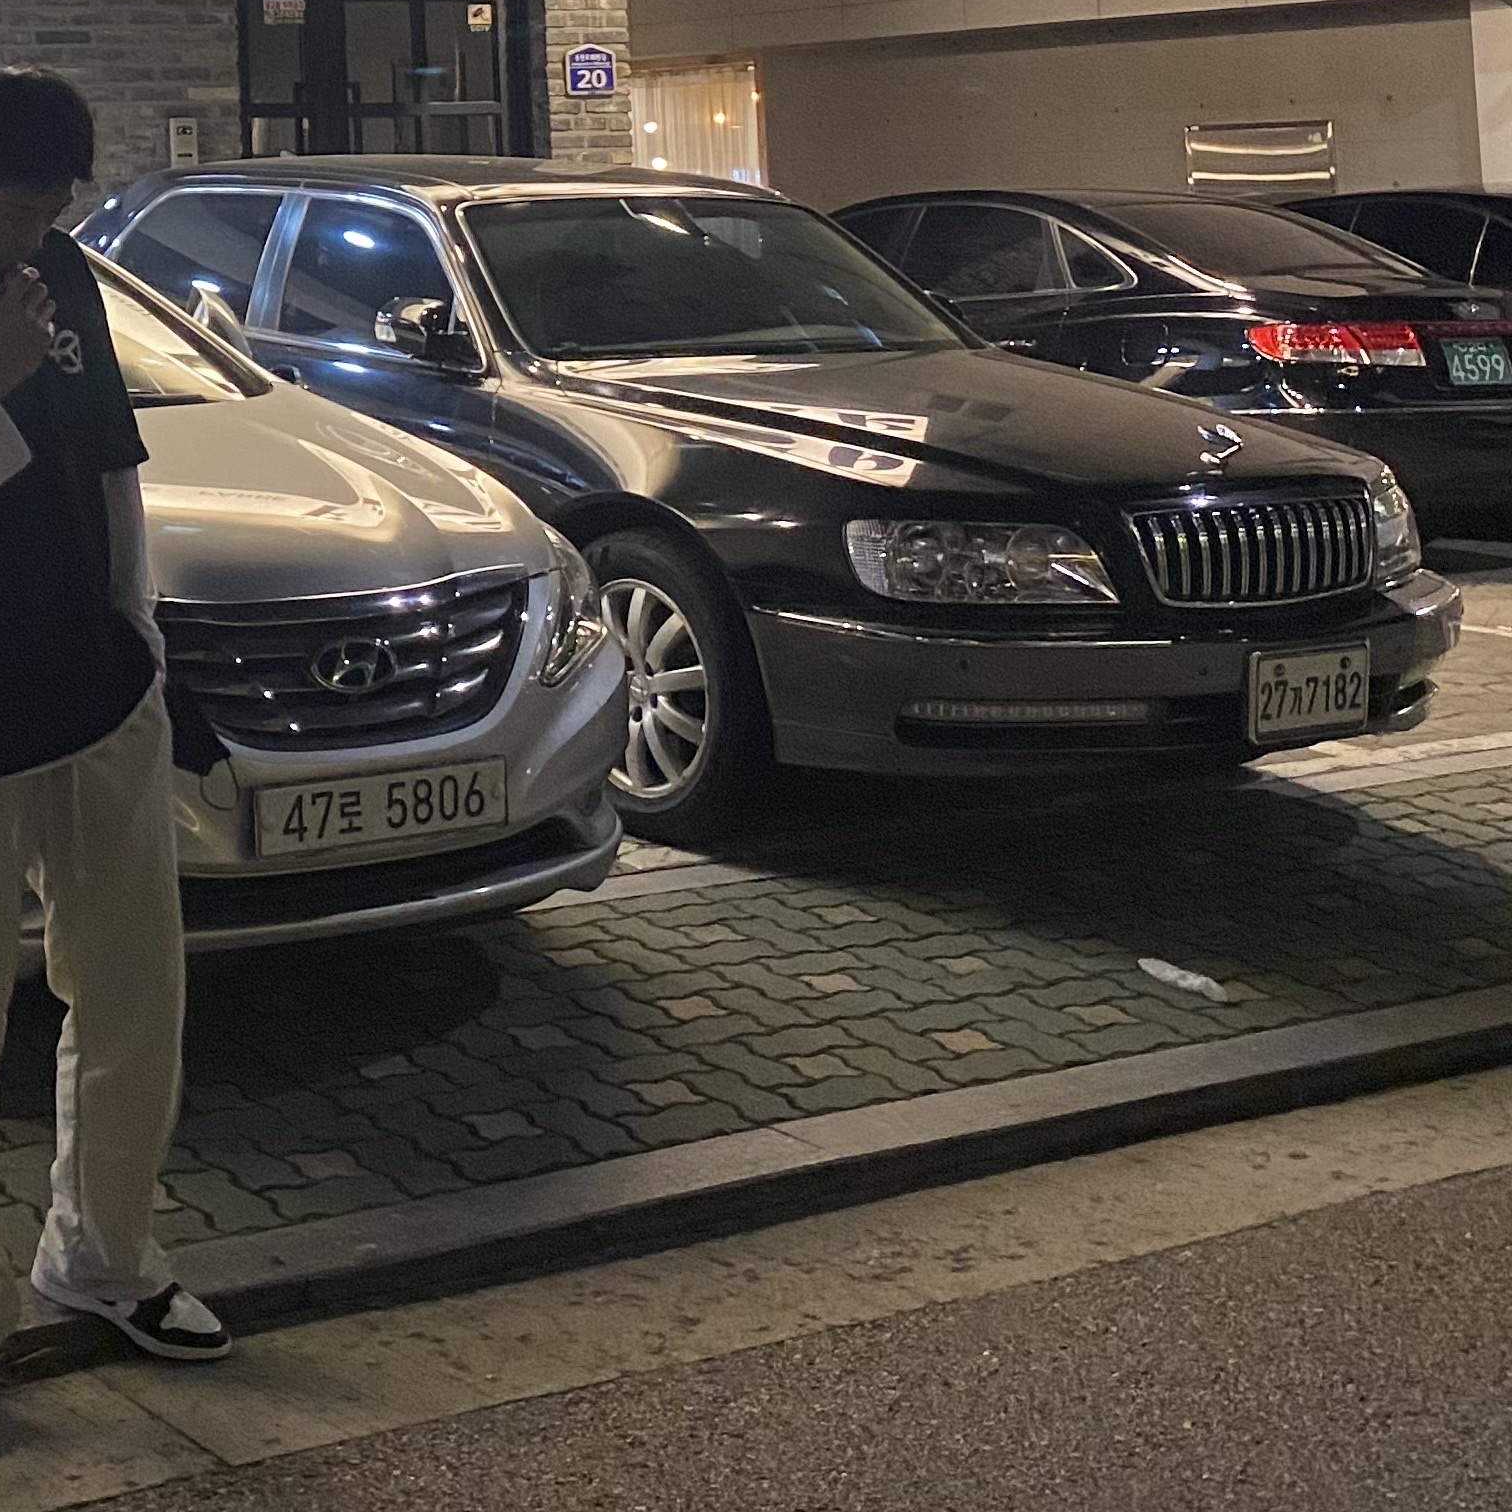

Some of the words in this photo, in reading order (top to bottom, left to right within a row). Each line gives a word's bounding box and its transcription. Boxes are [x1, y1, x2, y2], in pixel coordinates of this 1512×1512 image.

[576, 69, 608, 89] 20
[1451, 354, 1506, 383] 4599
[387, 771, 486, 830] 5806
